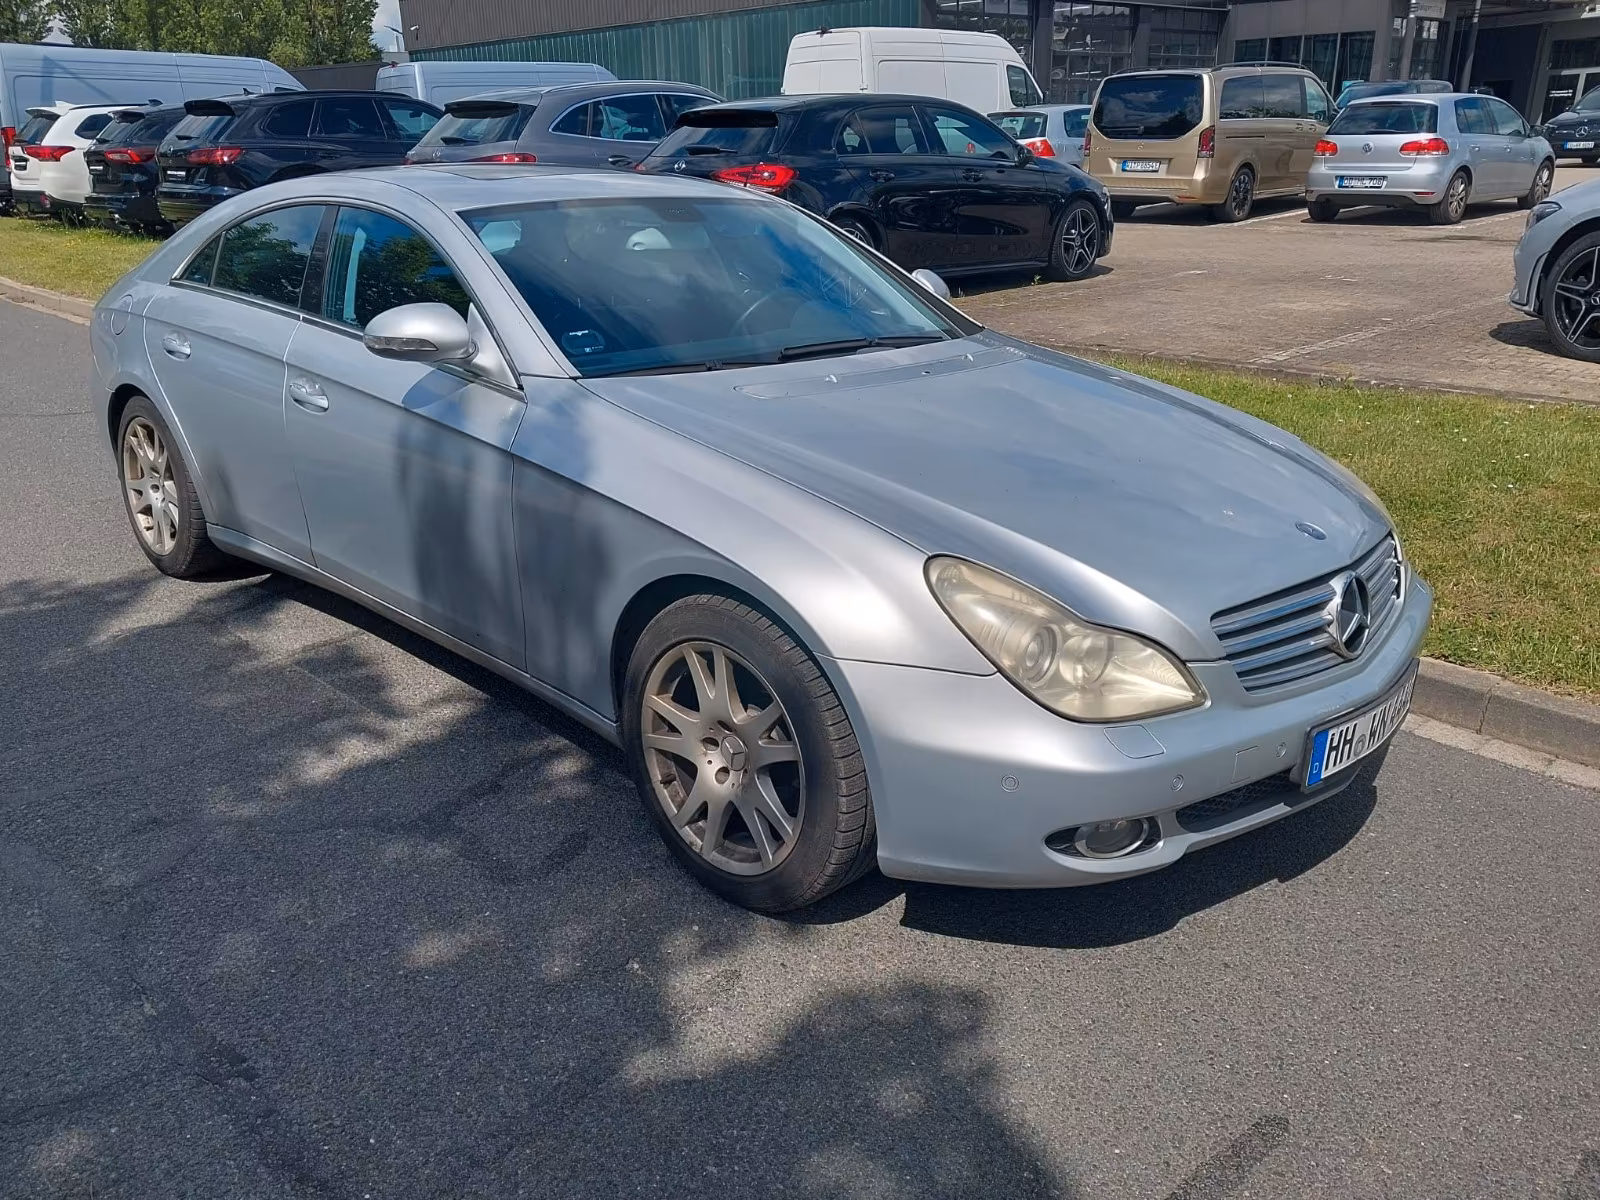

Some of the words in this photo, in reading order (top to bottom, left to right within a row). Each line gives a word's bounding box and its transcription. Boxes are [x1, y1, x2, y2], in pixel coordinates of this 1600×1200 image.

[1324, 722, 1358, 771] HH
[1367, 702, 1391, 749] WN
[1313, 762, 1319, 773] D
